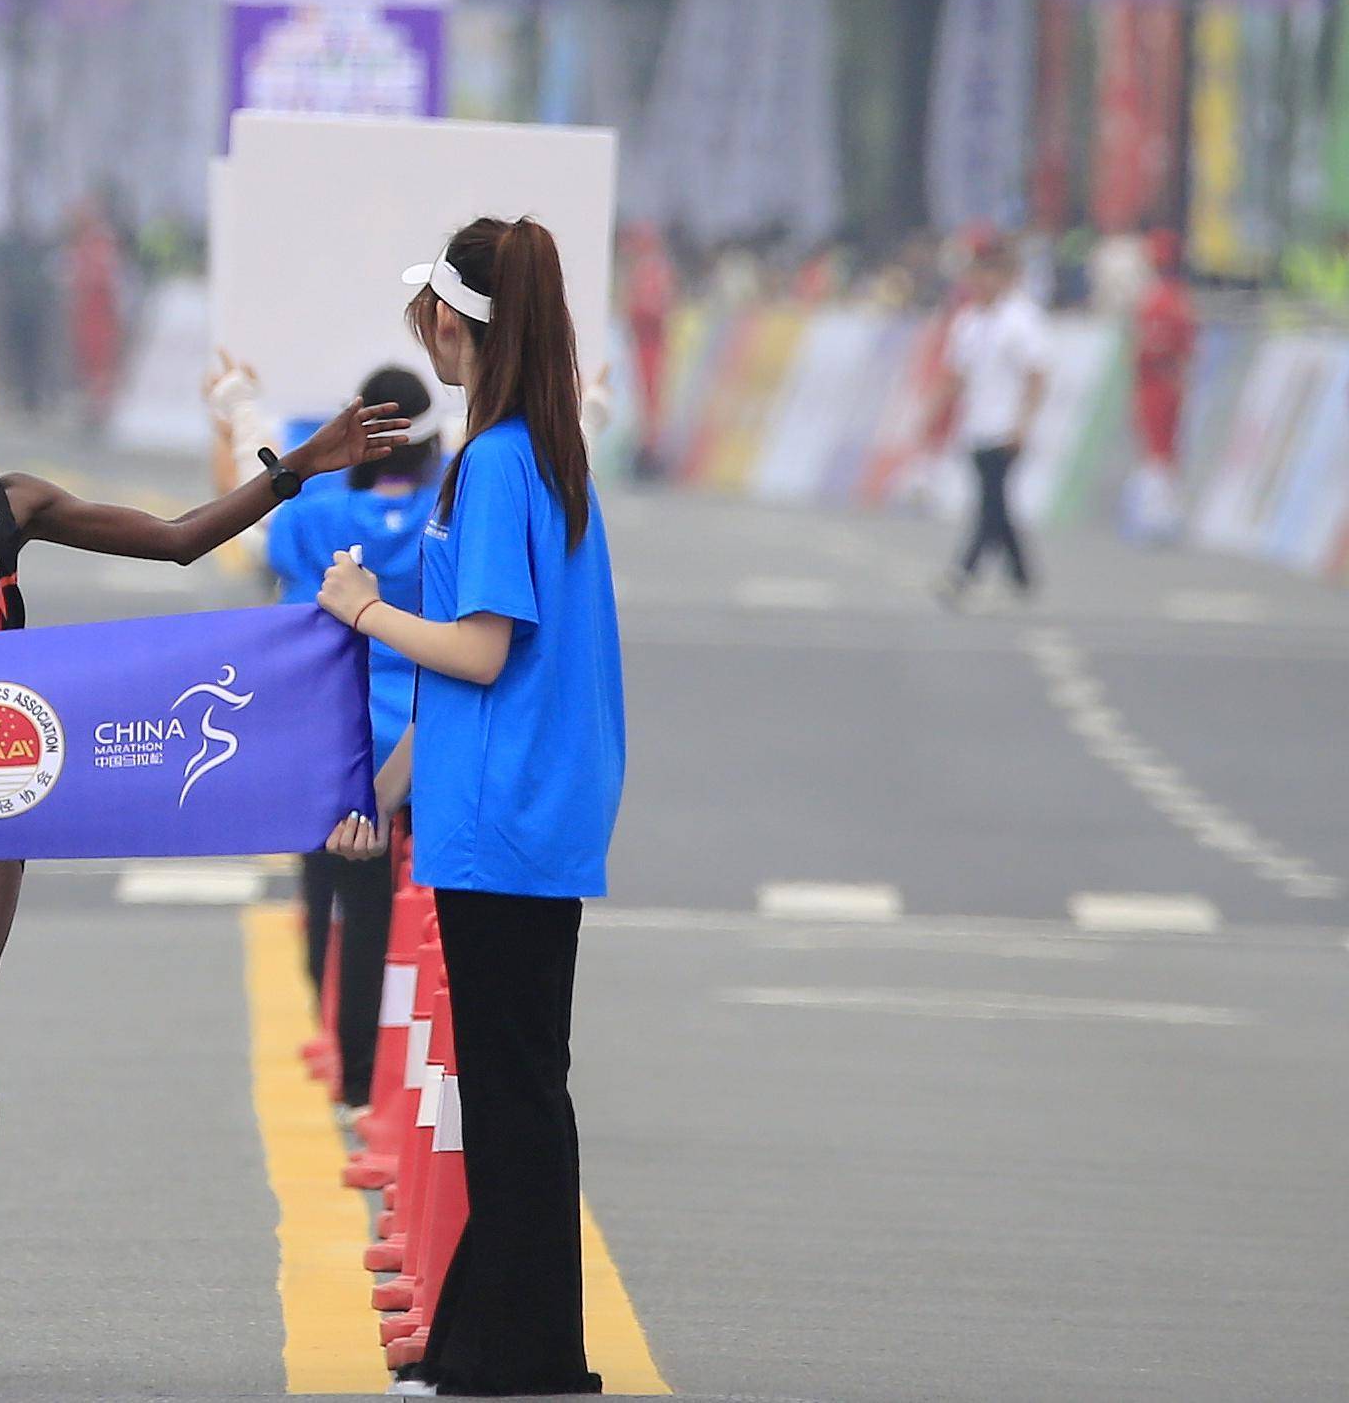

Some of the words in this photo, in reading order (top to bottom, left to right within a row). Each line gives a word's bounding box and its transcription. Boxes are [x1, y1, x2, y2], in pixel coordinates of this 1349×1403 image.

[12, 691, 59, 753] ASSOCIATION
[94, 718, 186, 745] CHINA
[94, 742, 164, 756] MARATHON
